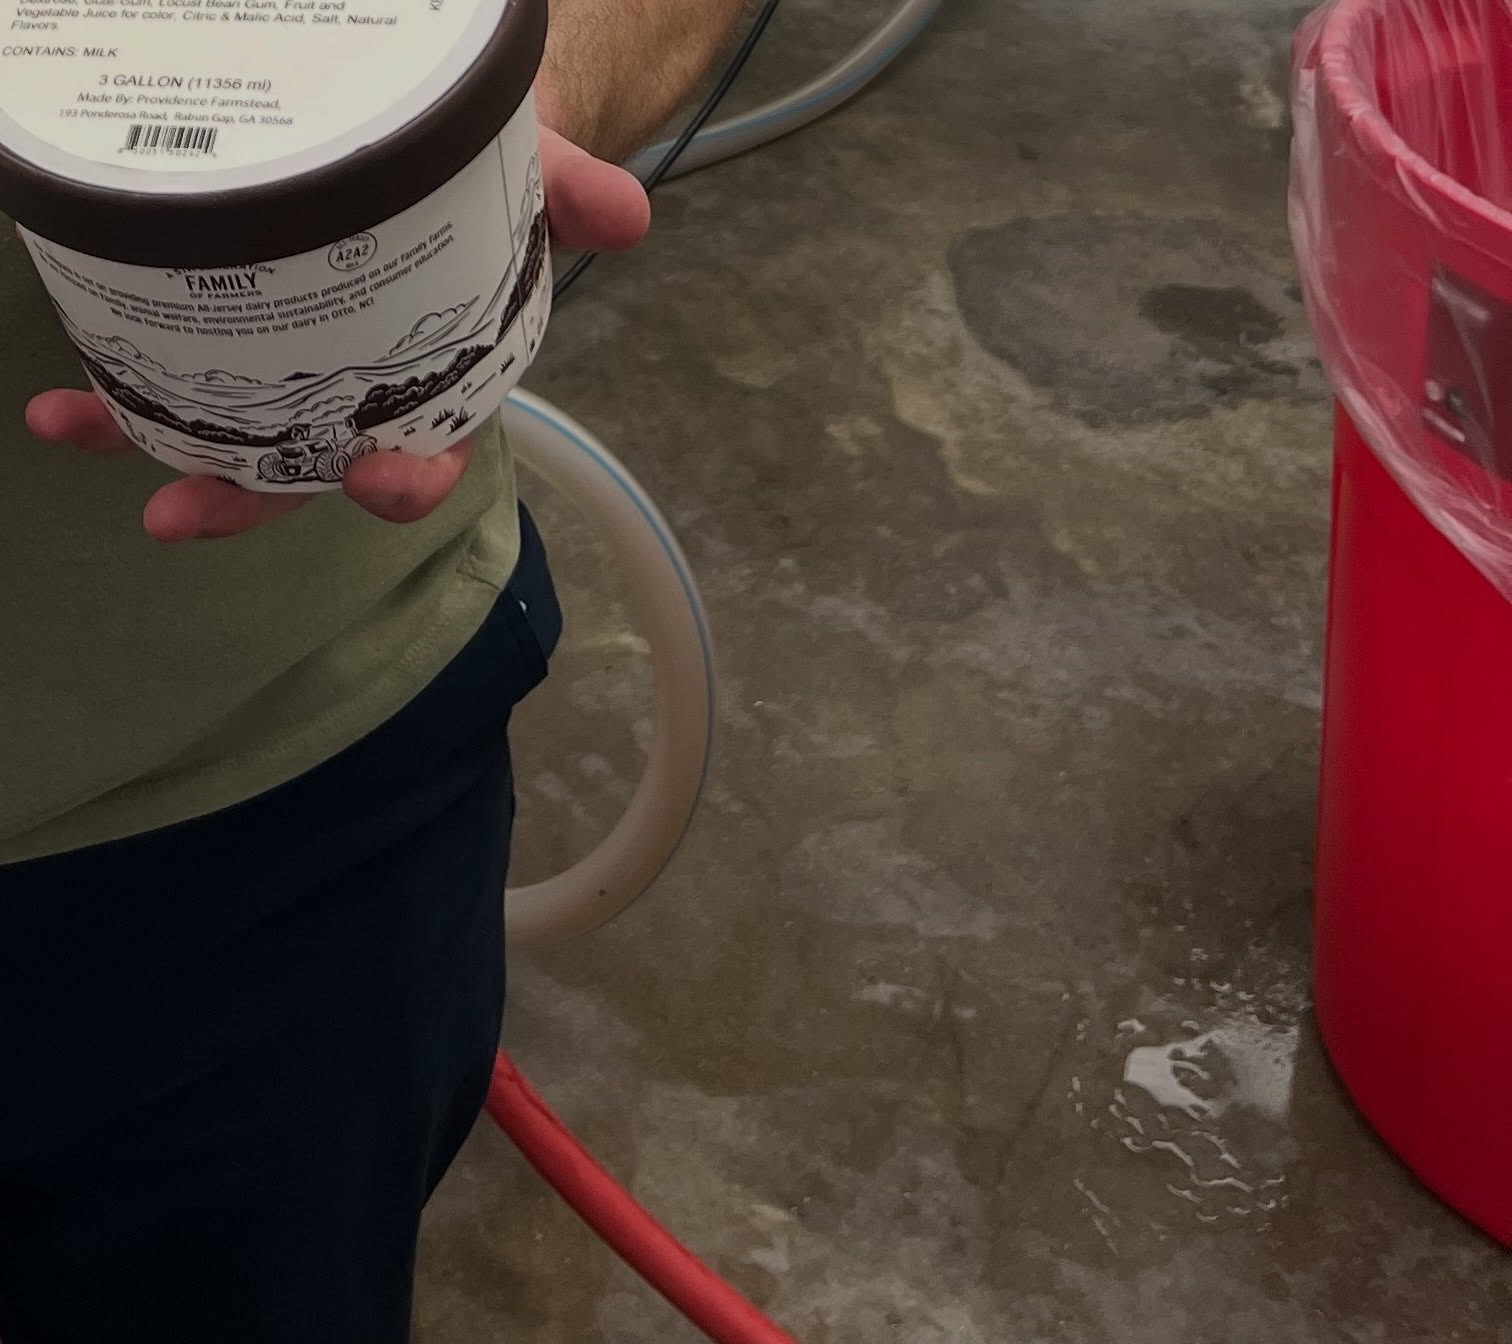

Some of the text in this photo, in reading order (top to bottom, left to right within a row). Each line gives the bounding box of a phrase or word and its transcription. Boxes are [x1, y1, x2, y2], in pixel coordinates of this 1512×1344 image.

[336, 243, 369, 262] A2A2
[185, 272, 256, 291] FAMILY
[246, 300, 270, 313] dairy
[273, 291, 318, 309] products
[321, 275, 366, 298] produced
[368, 268, 381, 279] on
[383, 257, 399, 271] our
[349, 287, 367, 301] and
[369, 265, 412, 292] consumer
[207, 290, 263, 299] FARMERS
[236, 326, 254, 338] you
[256, 325, 270, 334] on
[272, 323, 290, 333] our
[291, 317, 317, 331] dairy
[319, 313, 330, 322] in
